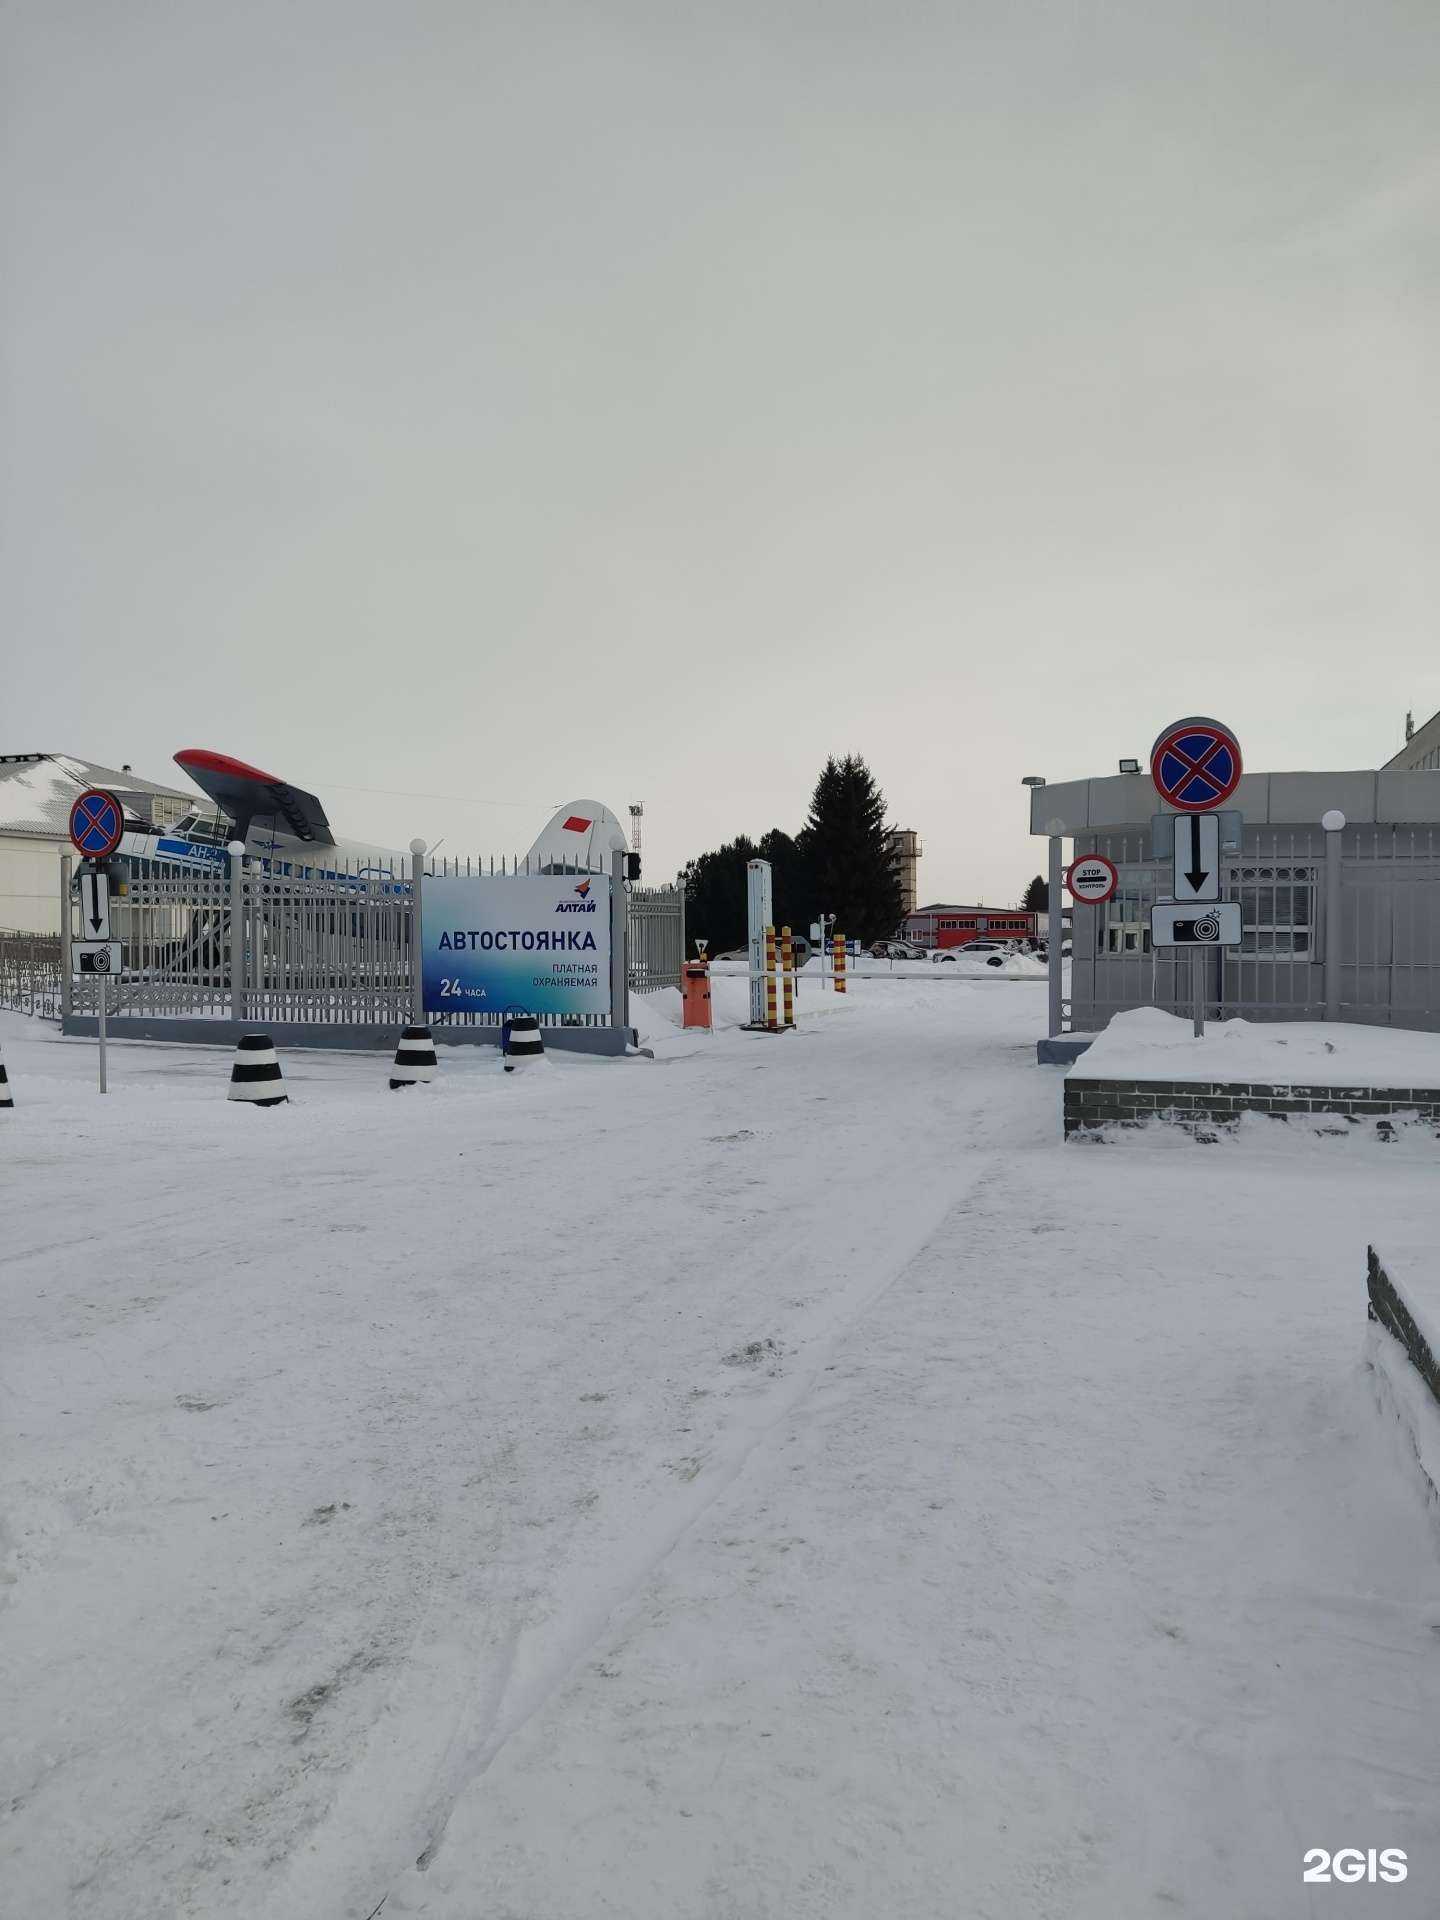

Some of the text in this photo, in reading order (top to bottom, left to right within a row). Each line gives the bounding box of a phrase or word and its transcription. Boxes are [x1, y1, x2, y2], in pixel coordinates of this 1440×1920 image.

[555, 900, 596, 913] АЛТАЙ
[438, 931, 597, 951] АВТОСТОЯНКА
[552, 964, 598, 974] ПЛАТНАЯ
[440, 978, 487, 998] 24 ЧАСА
[532, 977, 598, 987] ОХРАНЯЕМАЯ
